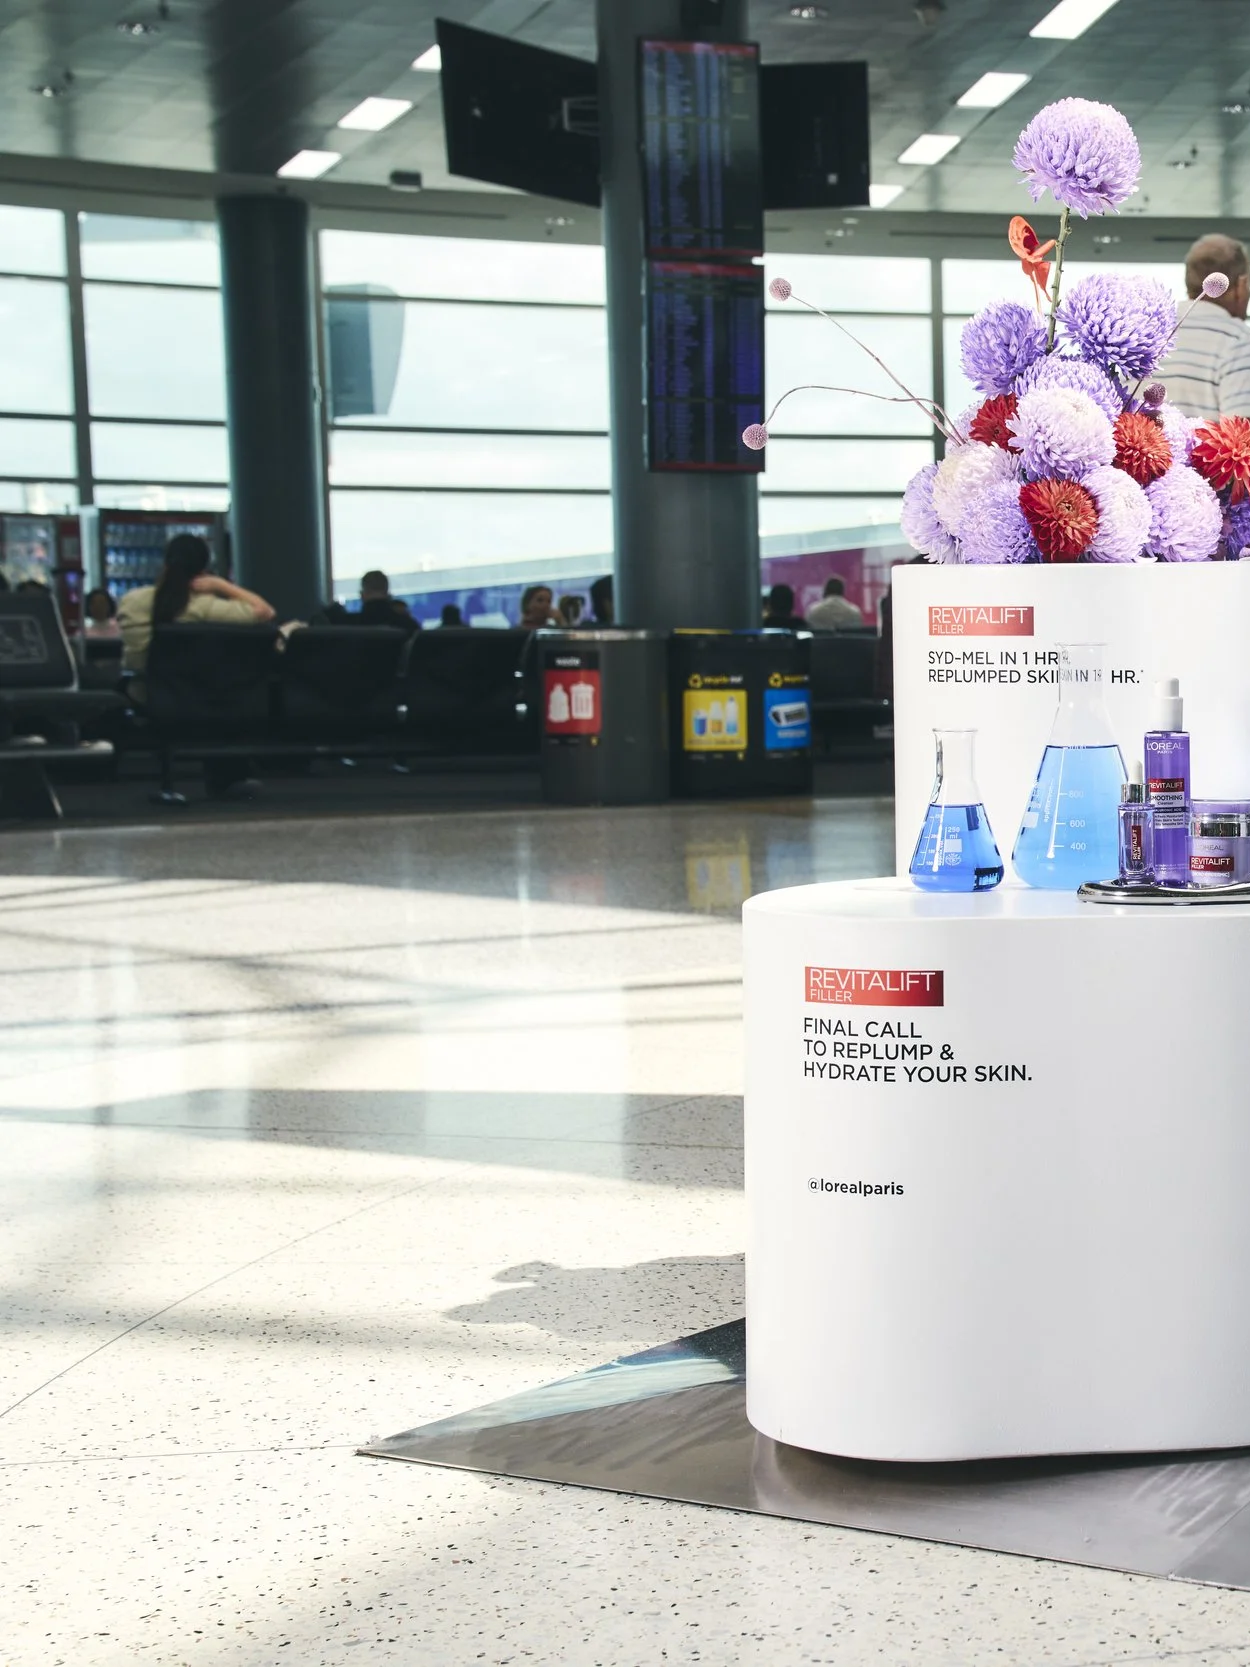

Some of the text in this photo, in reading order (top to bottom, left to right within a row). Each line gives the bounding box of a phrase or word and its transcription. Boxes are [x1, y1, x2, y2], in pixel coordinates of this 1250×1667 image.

[932, 608, 1028, 624] REVITALIFT
[932, 625, 964, 634] FILLER
[928, 651, 994, 665] SYD-MEL
[1000, 652, 1017, 665] IN
[1022, 652, 1028, 665] 1
[929, 670, 1021, 684] REPLUMPED
[1076, 669, 1088, 682] IN
[1069, 790, 1084, 799] 800
[1070, 820, 1085, 828] 600
[1070, 843, 1086, 851] 400
[810, 968, 936, 992] REVITALIFT
[810, 989, 852, 1002] FILLER
[804, 1017, 923, 1039] FINAL CALL
[804, 1040, 955, 1061] TO REPLUMP &
[804, 1062, 1033, 1083] HYDRATE YOUR SKIN.
[808, 1177, 904, 1197] @lorealparis
